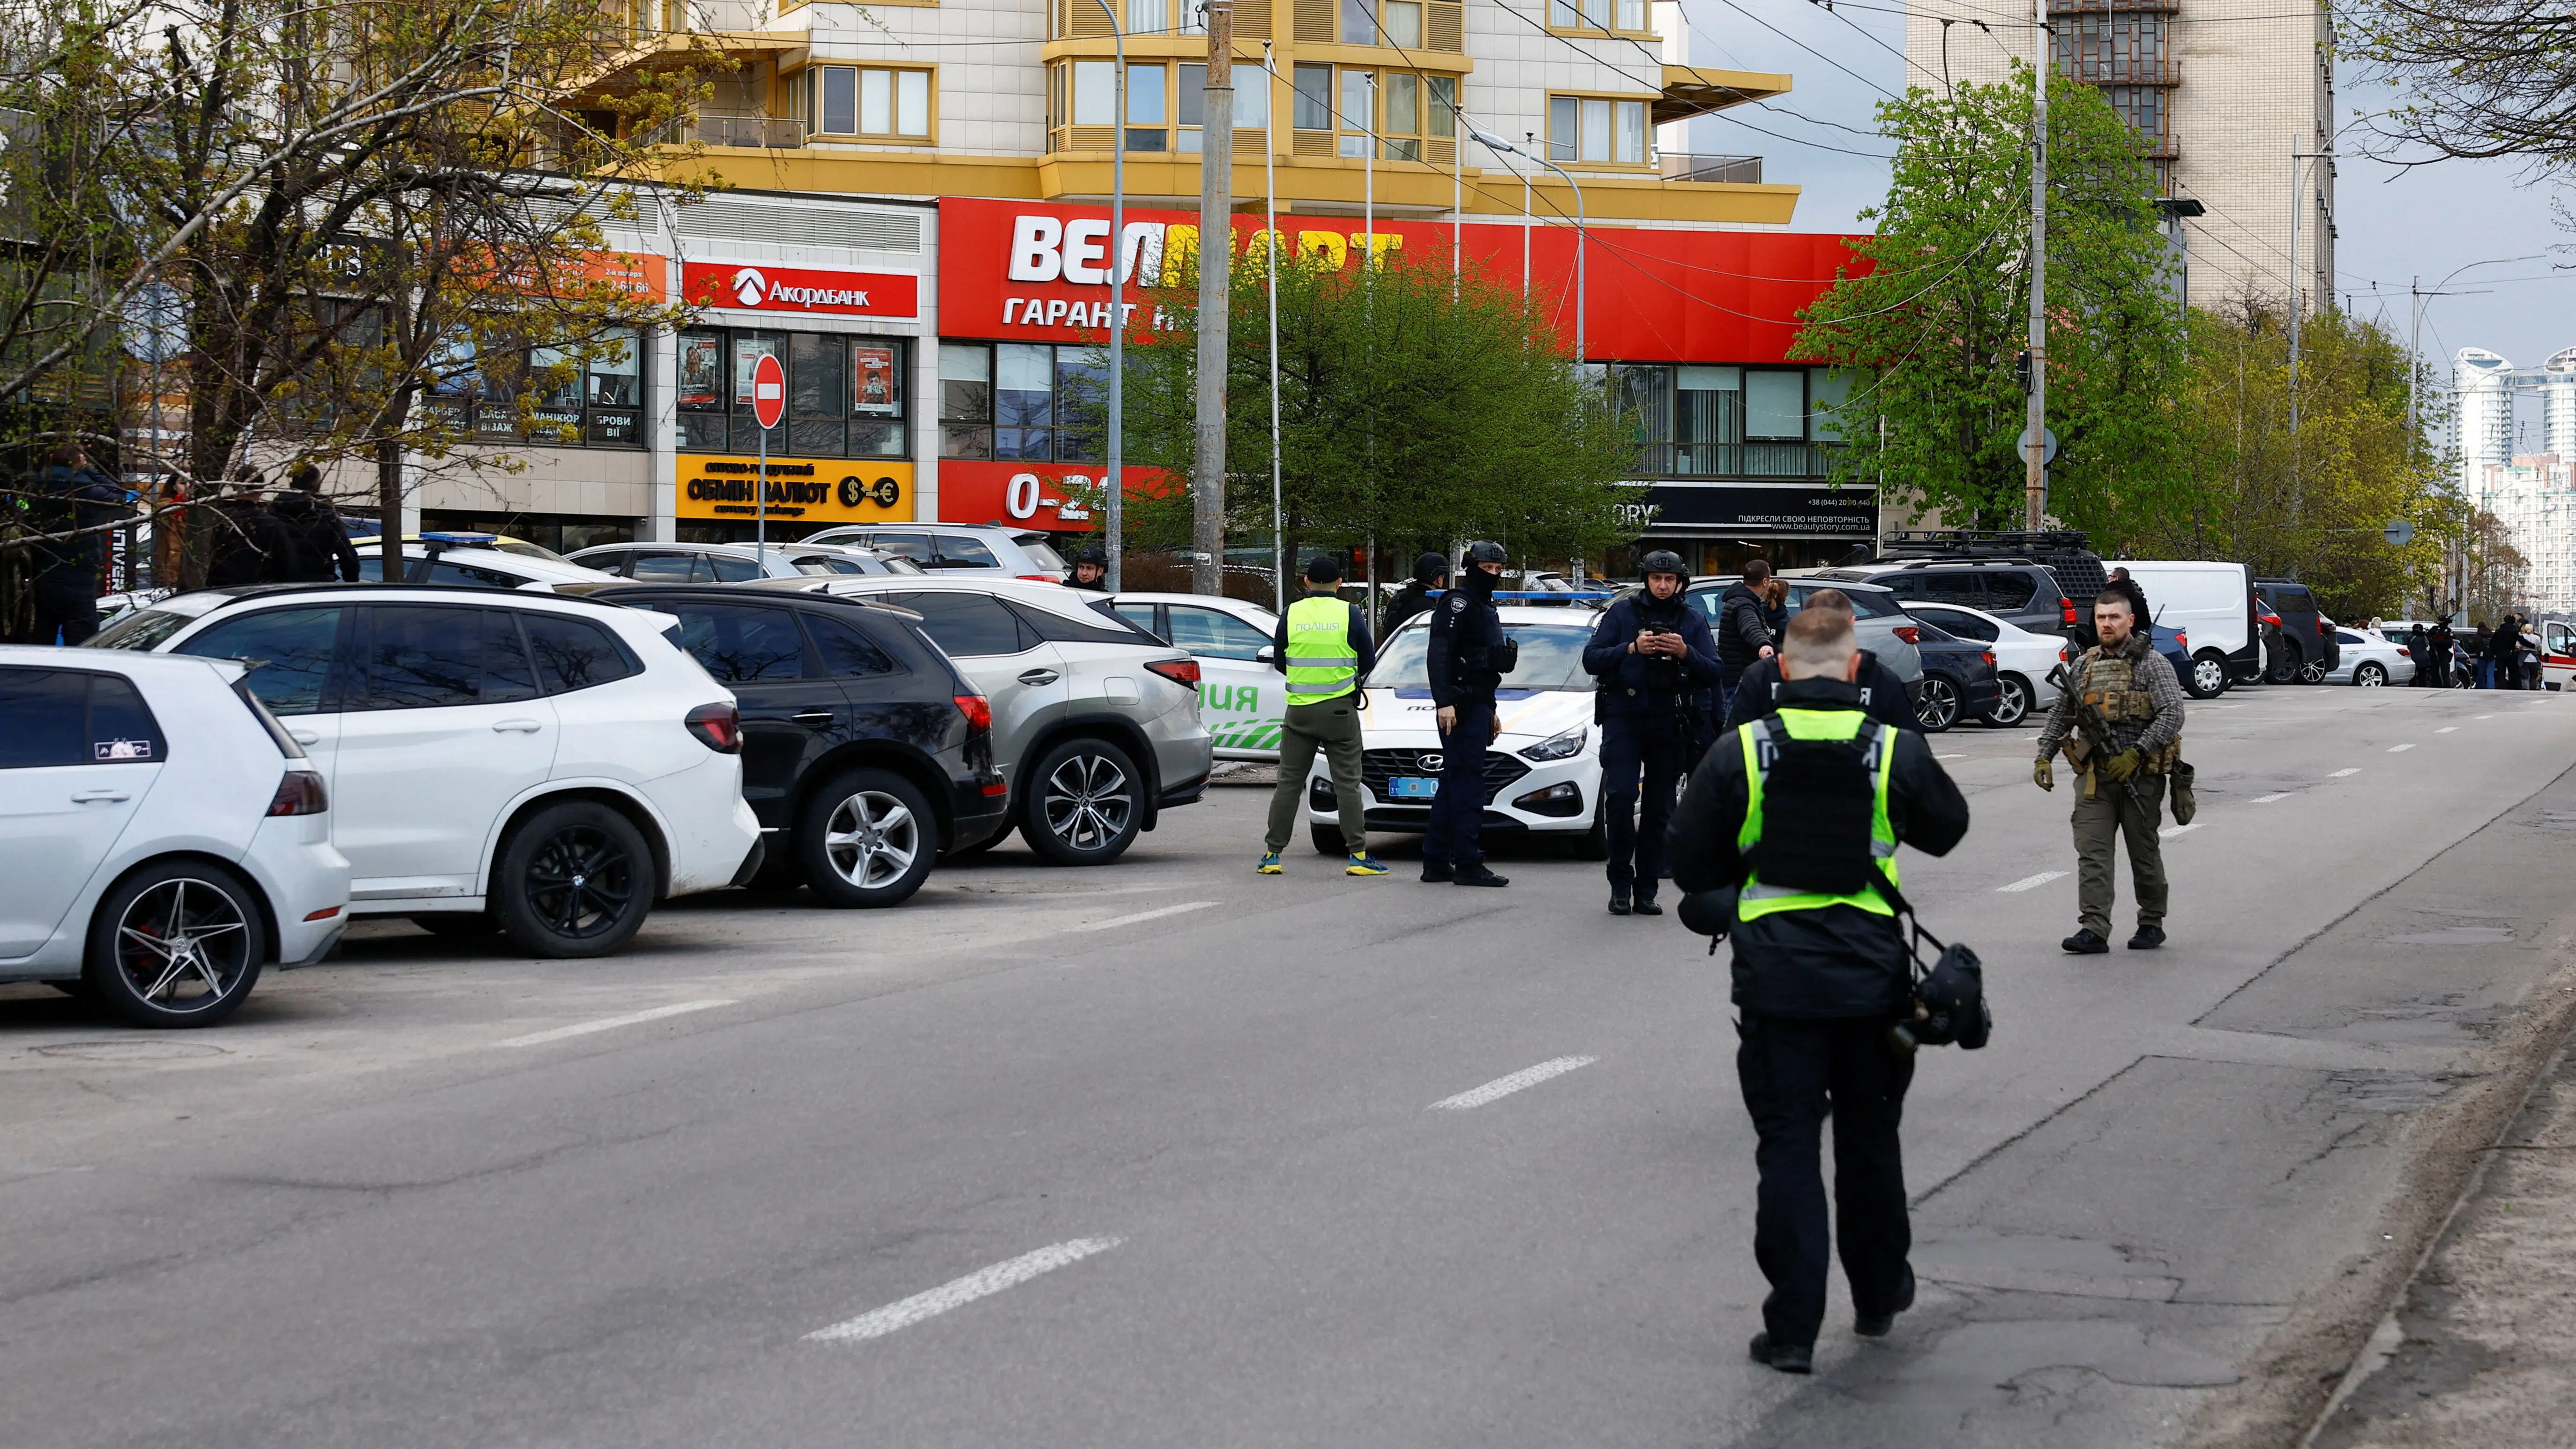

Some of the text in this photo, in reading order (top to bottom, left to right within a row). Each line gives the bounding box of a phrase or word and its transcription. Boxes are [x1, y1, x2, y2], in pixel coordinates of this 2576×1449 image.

[596, 416, 631, 426] БРОВИ
[481, 423, 513, 432] ВІЗАЖ
[606, 427, 620, 437] ВІЇ
[687, 478, 753, 501] ОБМІН
[757, 481, 831, 503] ВАЛЮТ
[1772, 523, 1870, 532] www.beautystory.com.ua
[1295, 622, 1340, 631] ПОЛІЦІЯ
